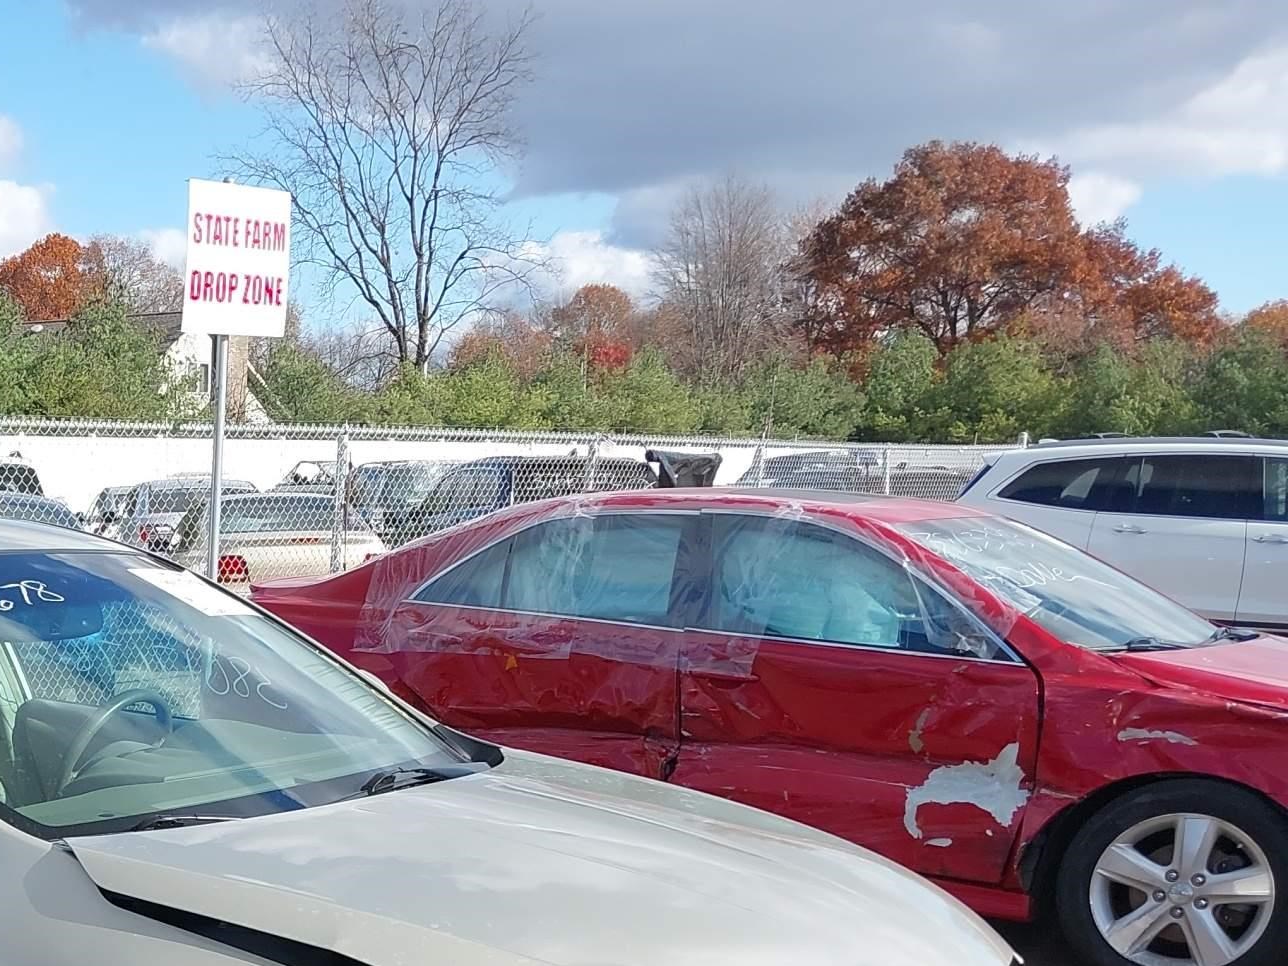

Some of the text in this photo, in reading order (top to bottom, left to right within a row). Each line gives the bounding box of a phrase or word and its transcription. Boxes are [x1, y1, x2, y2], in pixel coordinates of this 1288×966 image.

[193, 212, 286, 252] STATE FARM
[189, 270, 283, 307] DROP ZONE
